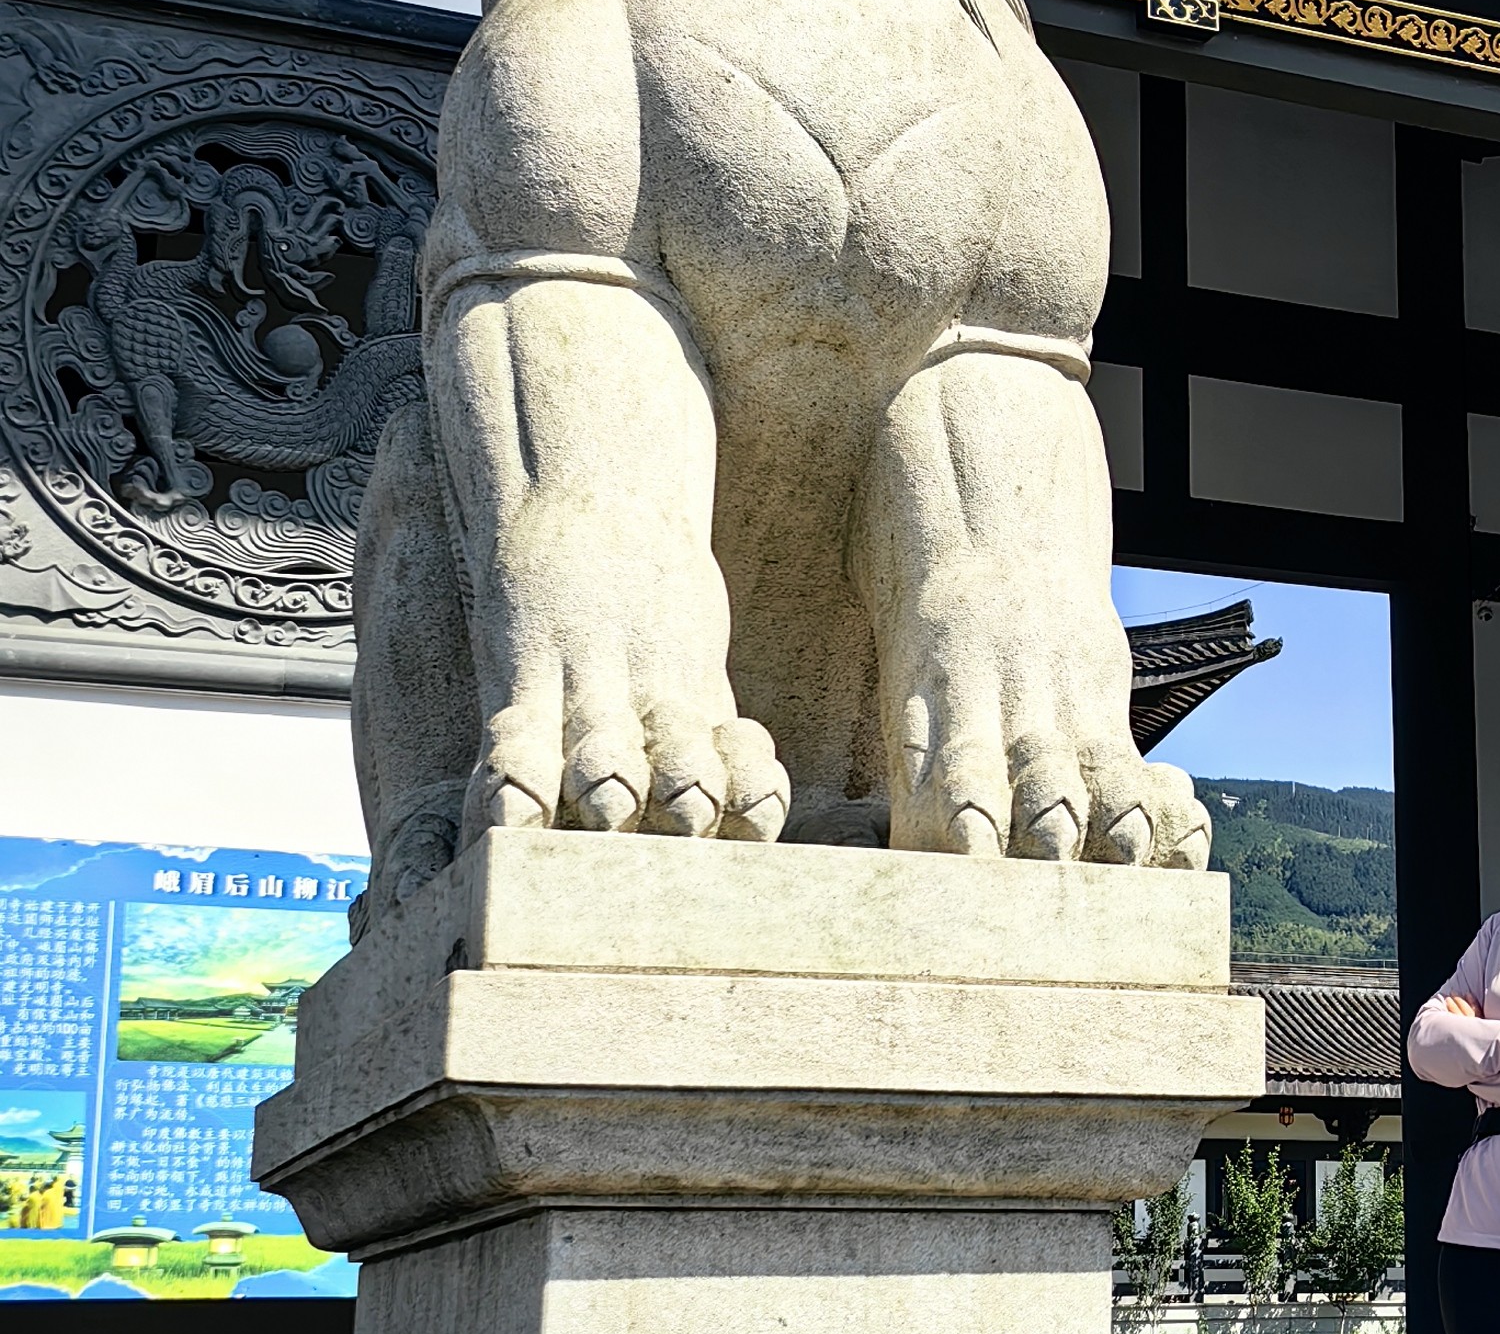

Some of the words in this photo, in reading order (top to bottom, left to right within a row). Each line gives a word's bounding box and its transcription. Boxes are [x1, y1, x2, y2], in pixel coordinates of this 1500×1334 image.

[153, 869, 367, 901] 峨眉后山柳江
